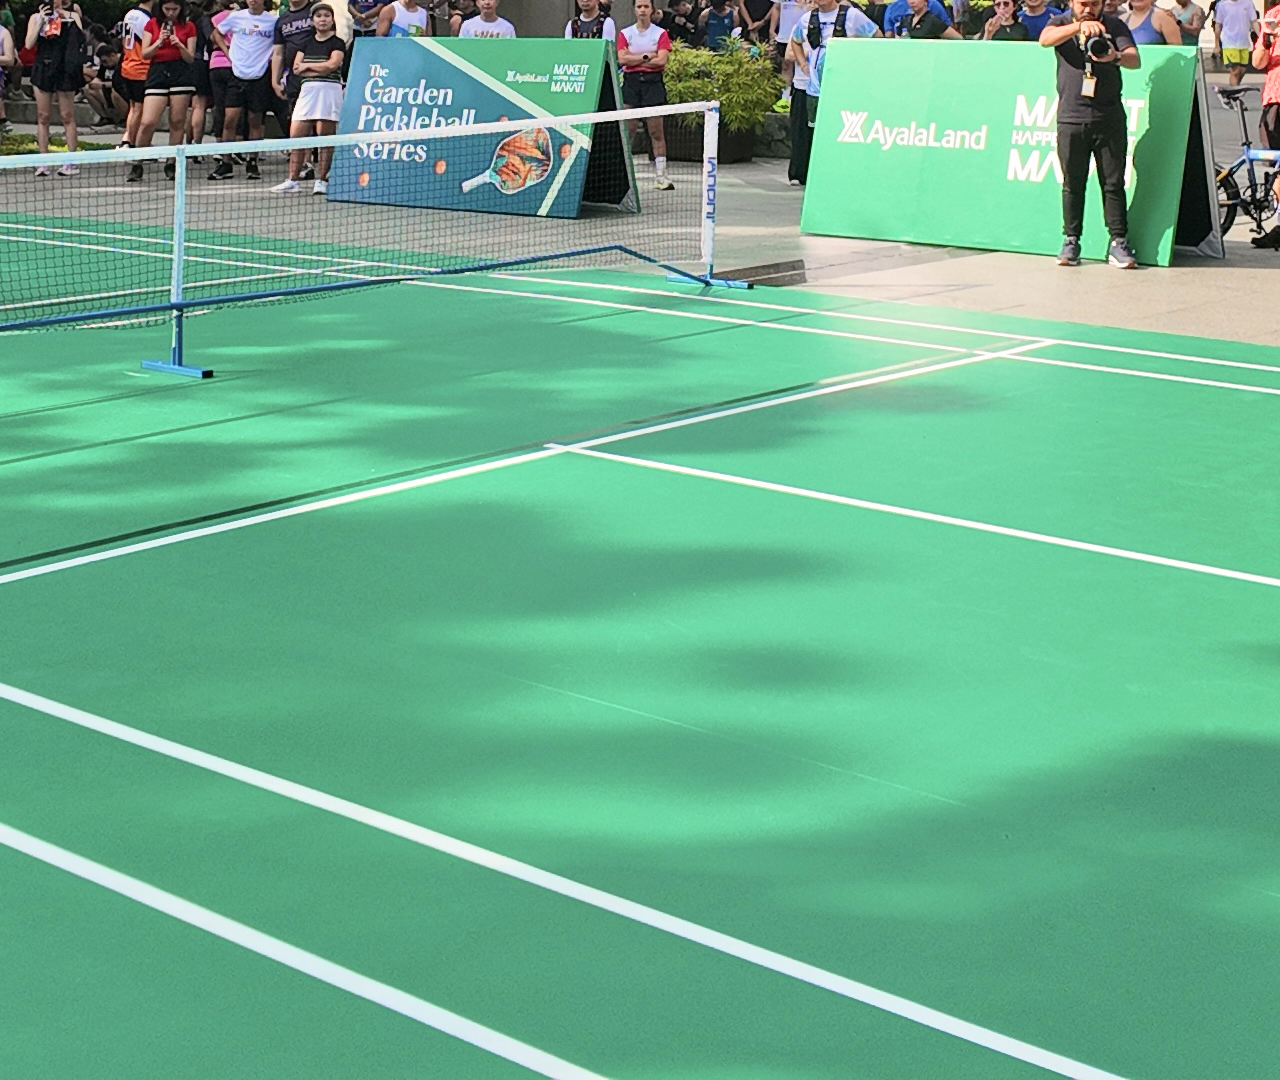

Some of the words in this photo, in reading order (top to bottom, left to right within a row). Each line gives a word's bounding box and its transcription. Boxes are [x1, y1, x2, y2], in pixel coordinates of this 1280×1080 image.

[368, 63, 390, 78] The
[364, 78, 453, 107] Garden
[357, 104, 477, 133] Pickleball
[866, 119, 988, 151] AyalaLand
[1011, 129, 1059, 147] HAPPE
[353, 142, 428, 162] Series
